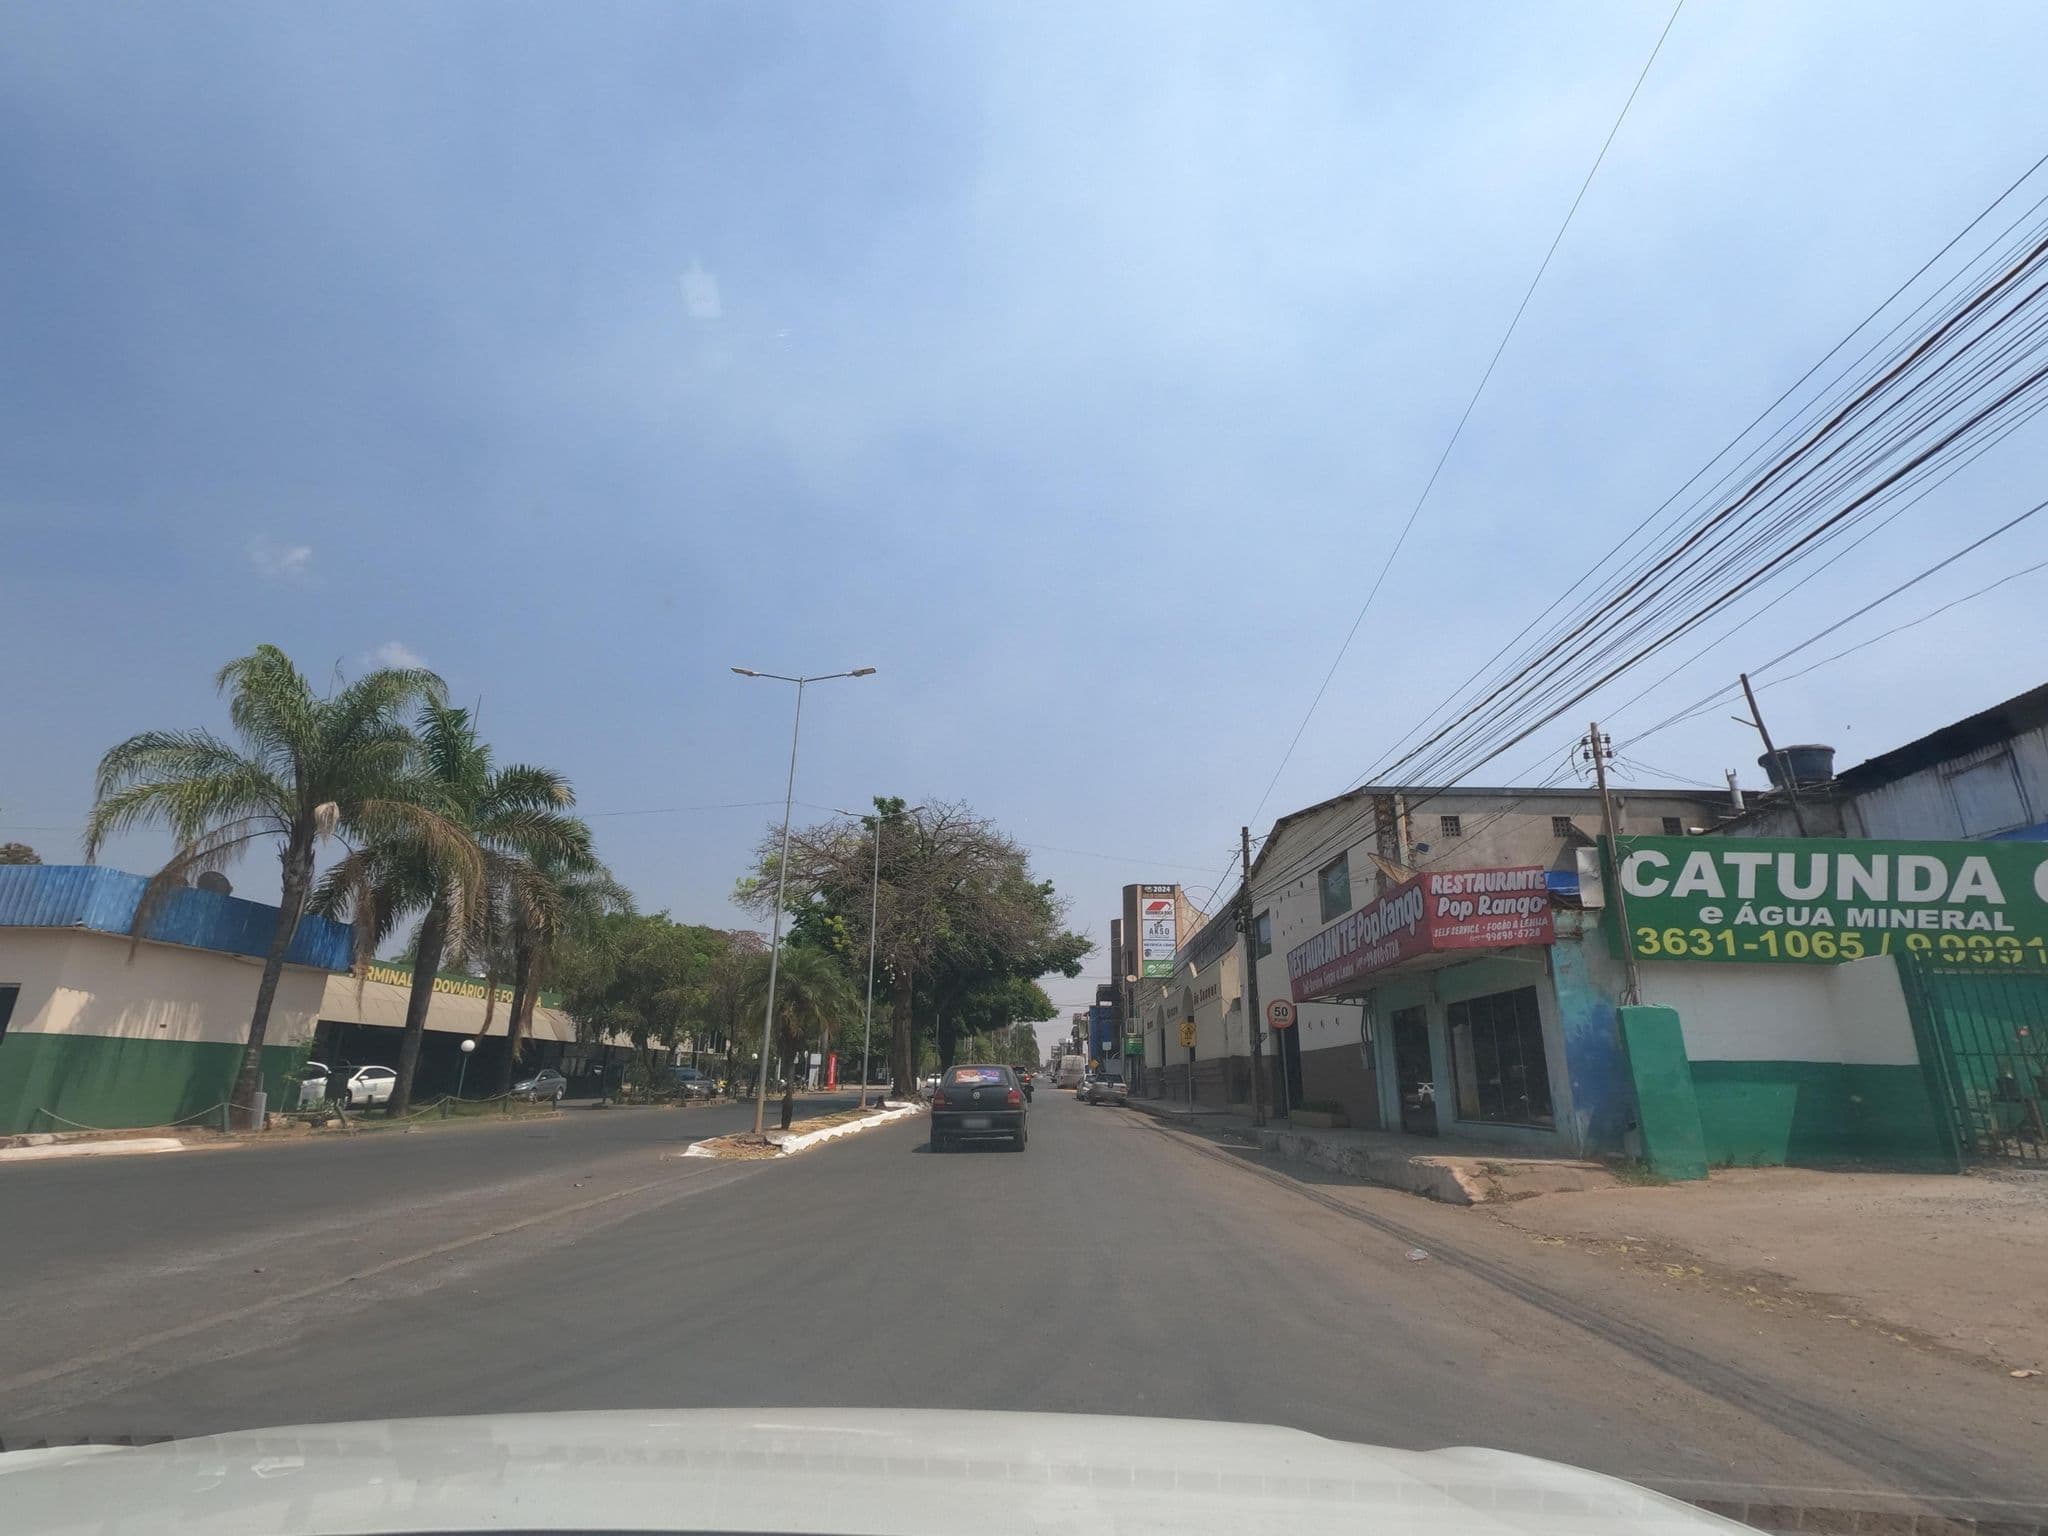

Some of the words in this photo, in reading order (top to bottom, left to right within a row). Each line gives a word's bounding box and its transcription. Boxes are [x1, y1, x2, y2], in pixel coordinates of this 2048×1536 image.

[1431, 870, 1546, 894] RESTAURANTE
[1621, 850, 2006, 905] CATUNDA
[1437, 897, 1473, 921] Pop
[1477, 895, 1548, 919] Rango
[1699, 906, 1725, 924] e
[1734, 901, 1835, 926] ÁGUA
[1847, 908, 2016, 931] MINERAL
[1287, 916, 1357, 978] RESTAURANTE
[1357, 912, 1380, 948] Pop
[1379, 886, 1424, 937] Rango
[1637, 927, 1865, 960] 3631-1065
[365, 966, 413, 987] RMINAL
[433, 978, 484, 999] DOVIÁRIO
[1273, 1006, 1289, 1017] 50
